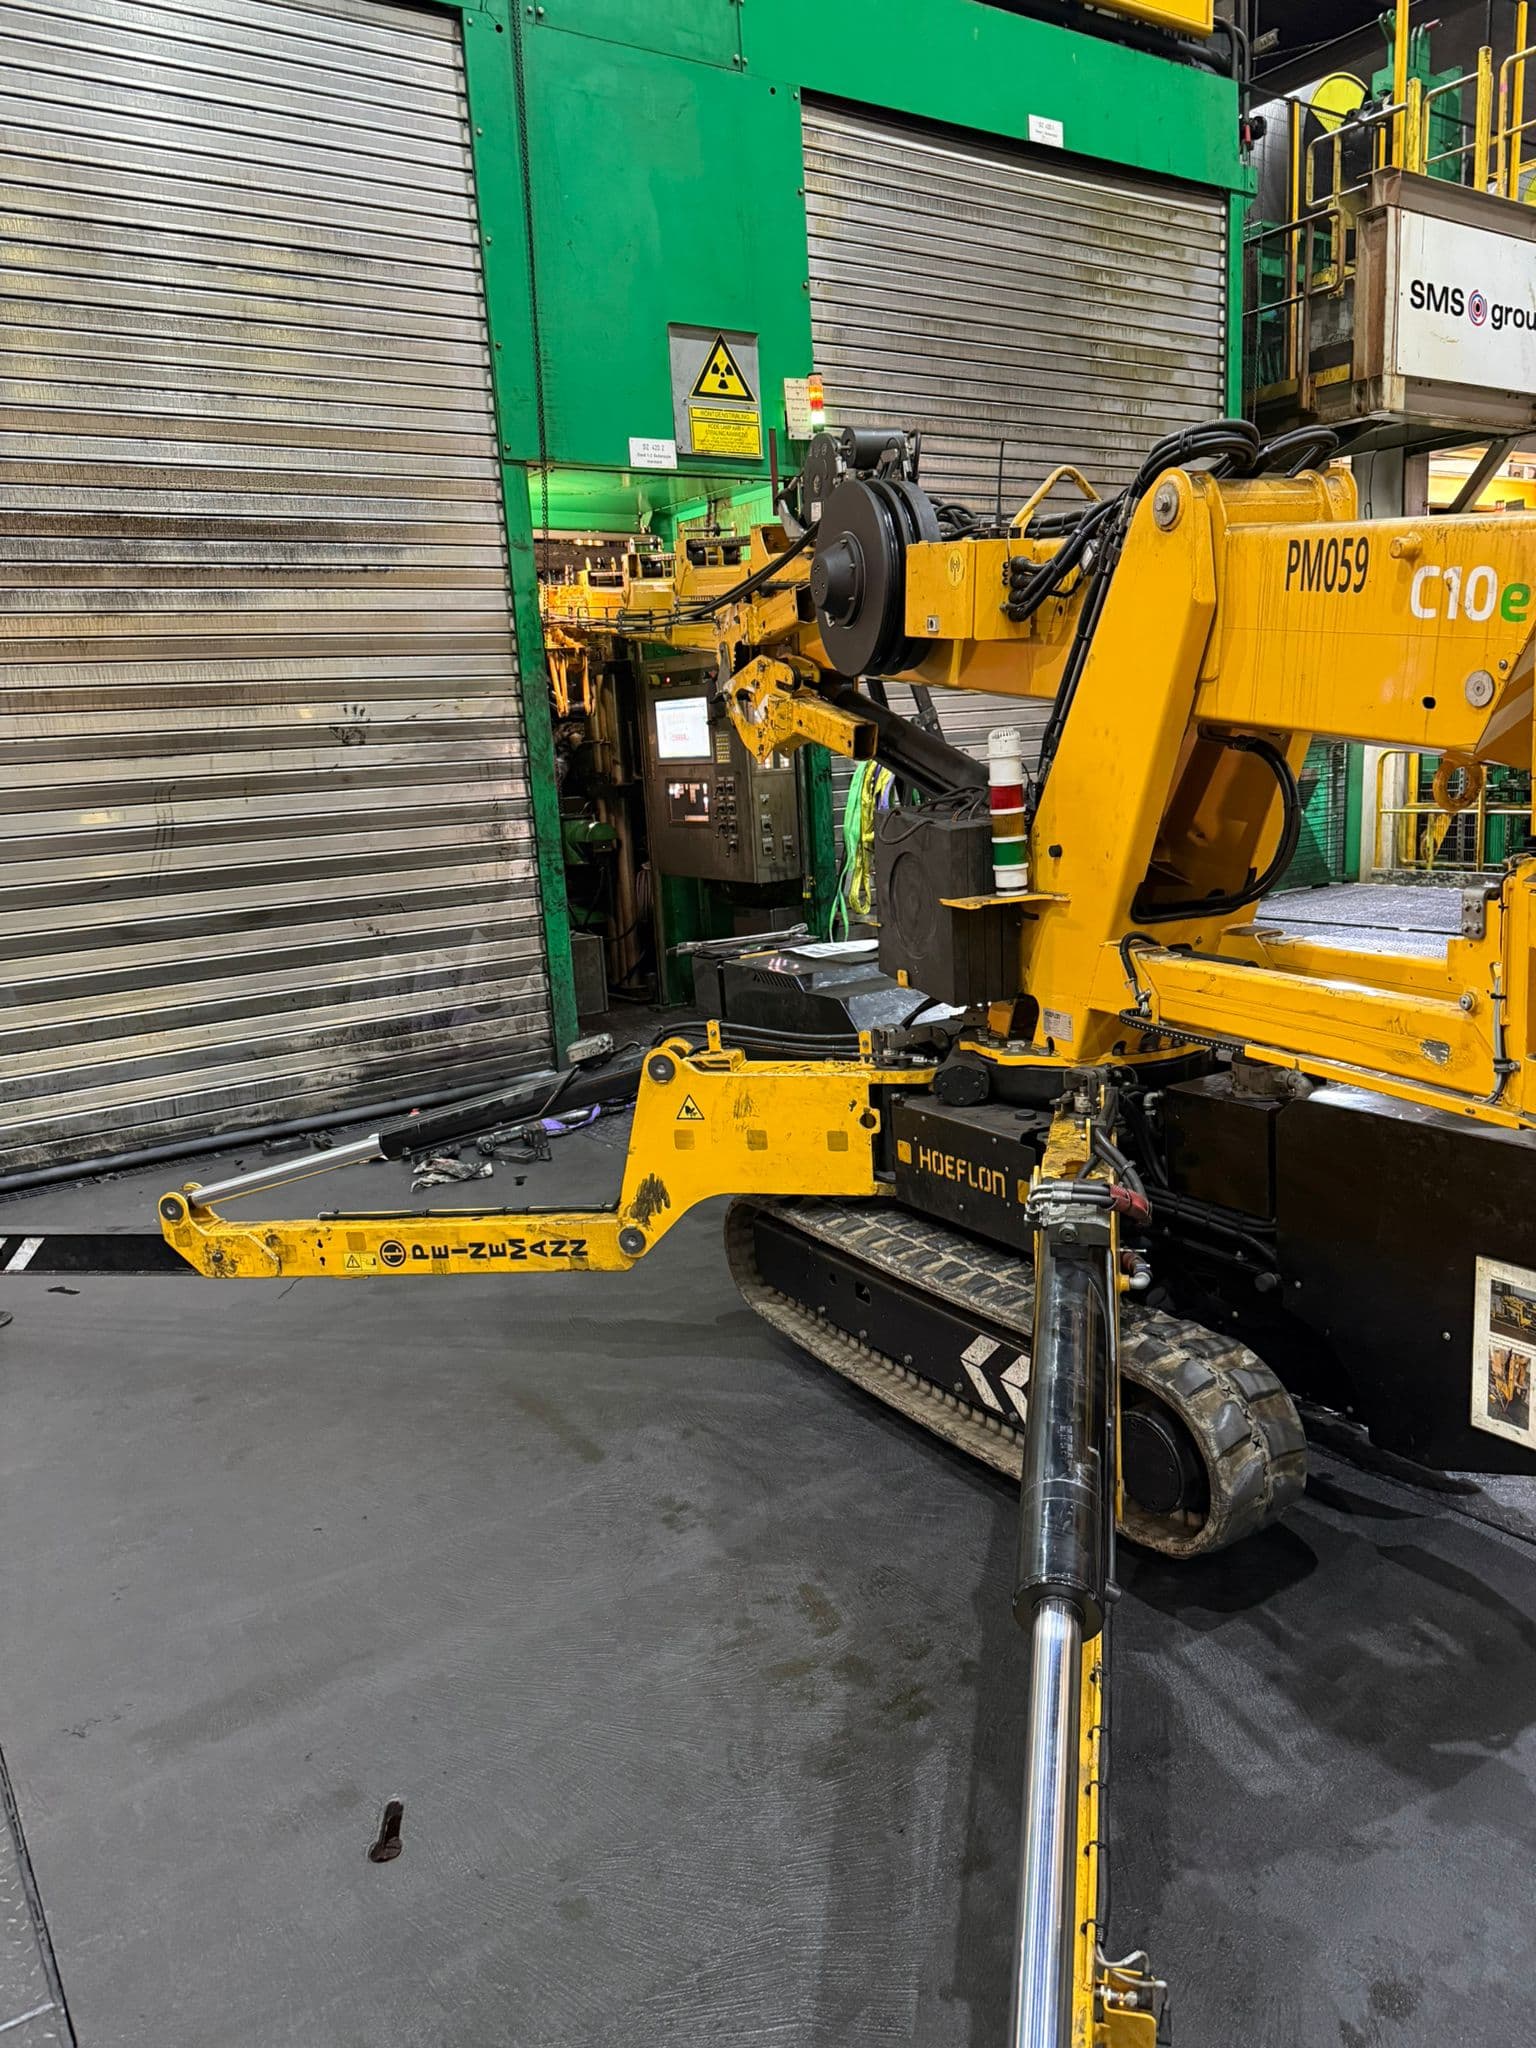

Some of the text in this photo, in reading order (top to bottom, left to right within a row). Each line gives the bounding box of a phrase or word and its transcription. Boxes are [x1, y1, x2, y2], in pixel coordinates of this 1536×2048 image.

[1410, 280, 1536, 330] SMS grou
[1286, 537, 1369, 593] PM059
[920, 1146, 1006, 1198] HOEFLON
[411, 1238, 589, 1260] PEINEMANN
